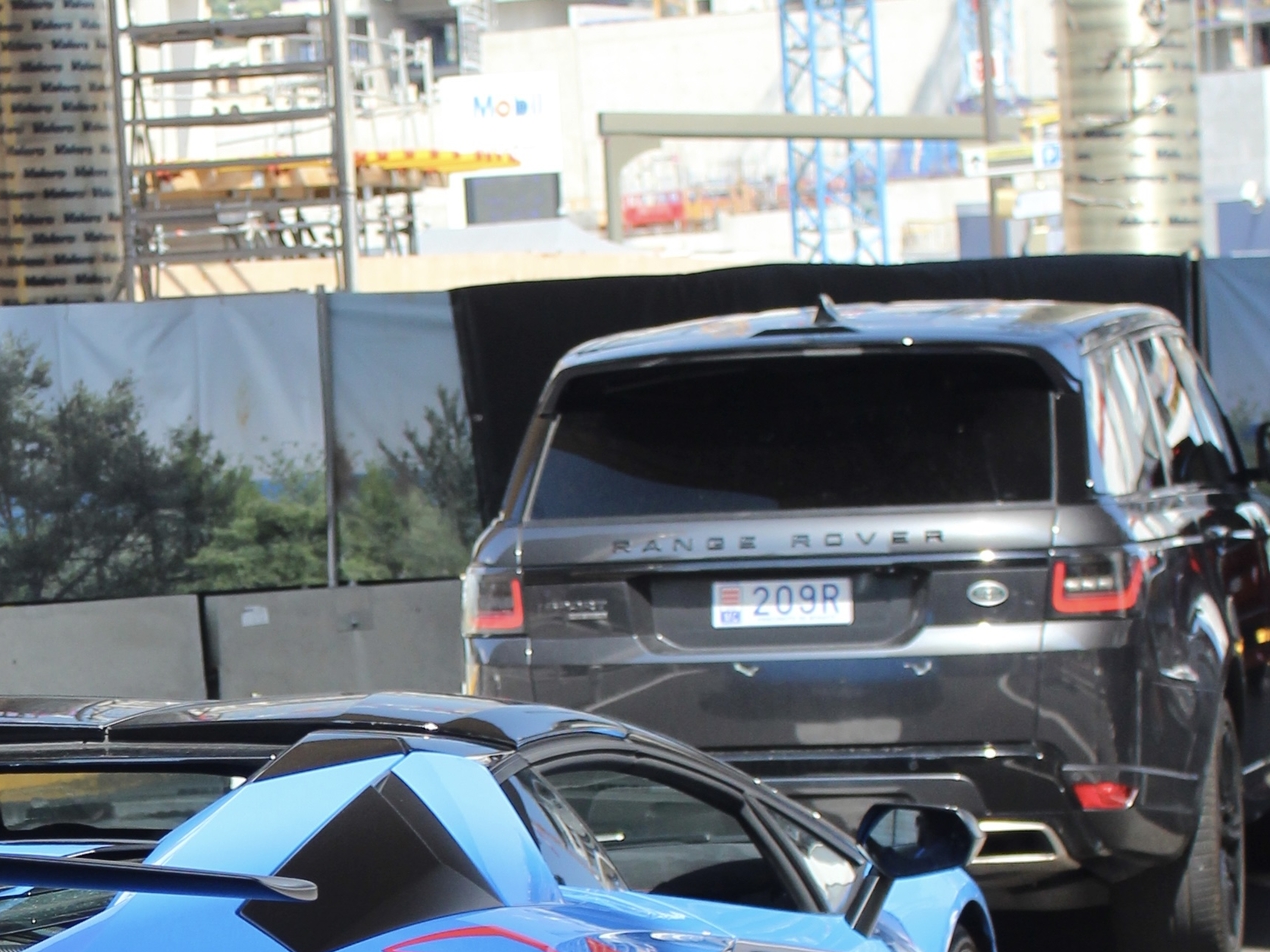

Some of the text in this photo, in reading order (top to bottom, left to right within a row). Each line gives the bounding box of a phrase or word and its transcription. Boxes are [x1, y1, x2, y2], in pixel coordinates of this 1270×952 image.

[613, 530, 946, 553] RANGE ROVER
[753, 584, 840, 615] 209R
